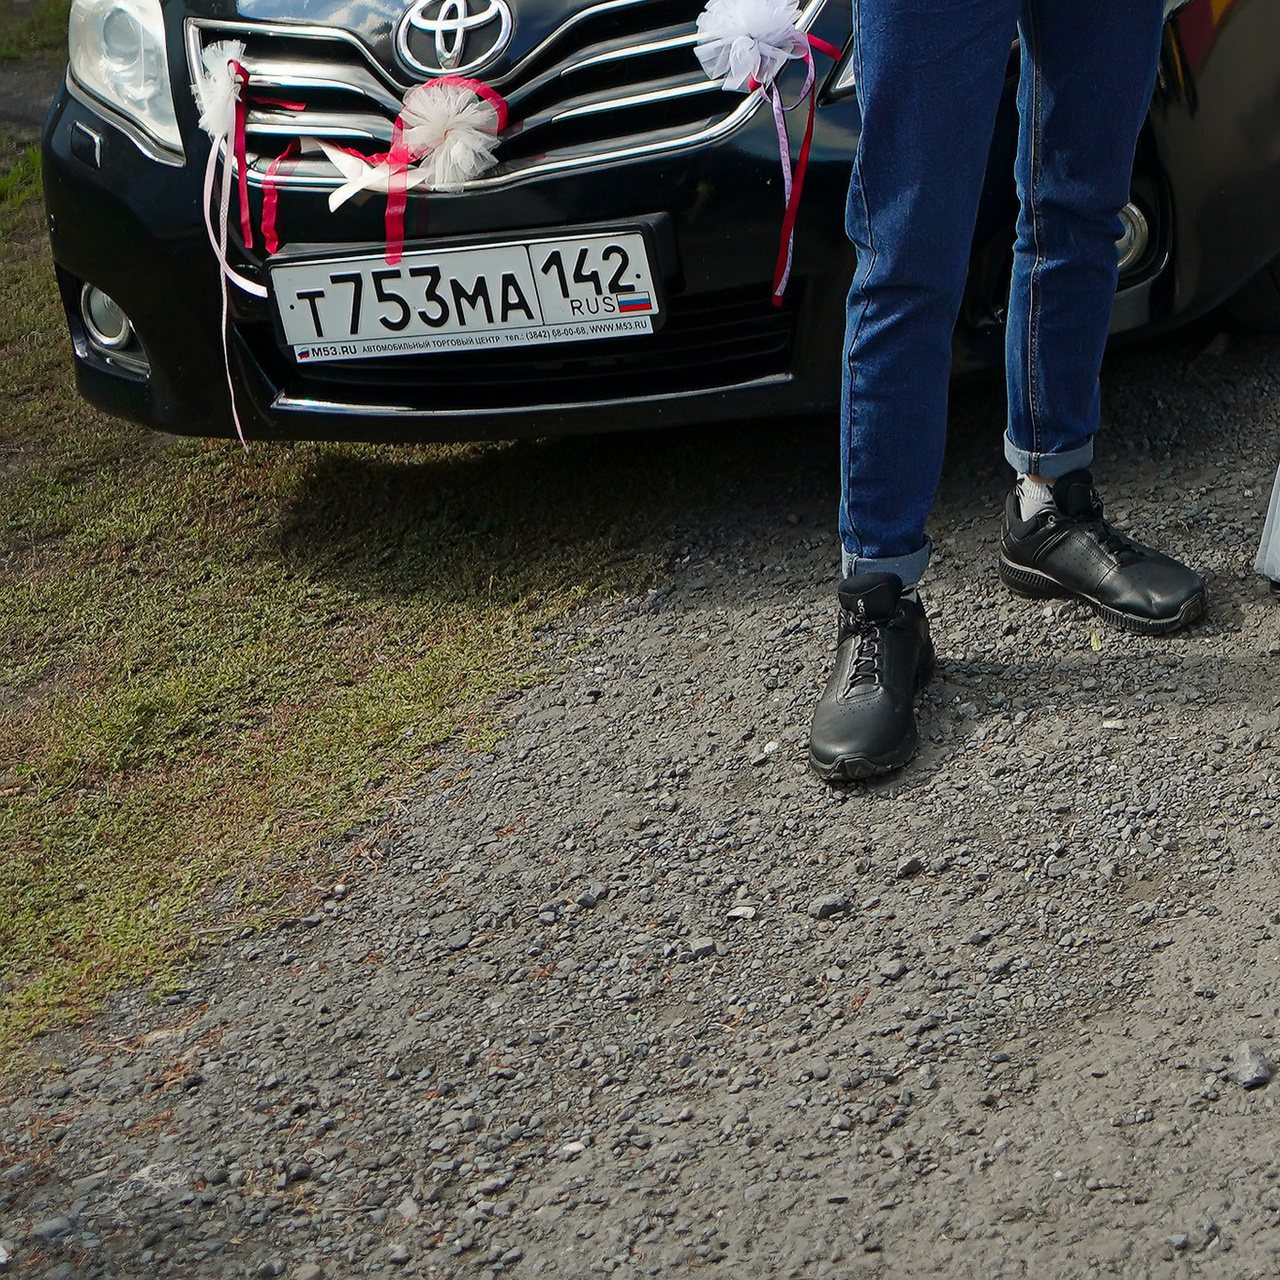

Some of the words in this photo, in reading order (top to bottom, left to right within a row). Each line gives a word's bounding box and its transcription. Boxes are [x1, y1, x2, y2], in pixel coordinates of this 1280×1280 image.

[296, 265, 535, 338] Т753МА
[541, 244, 636, 299] 142
[569, 297, 616, 316] RUS
[311, 344, 357, 357] M53.RU
[362, 338, 431, 353] АВТОМОБИЛЬНЫЙ
[432, 335, 475, 348] ТОРГОВЫЙ
[475, 334, 501, 345] ЦЕНТР
[525, 328, 550, 341] (3842)
[589, 320, 648, 334] WWW.M53.RU
